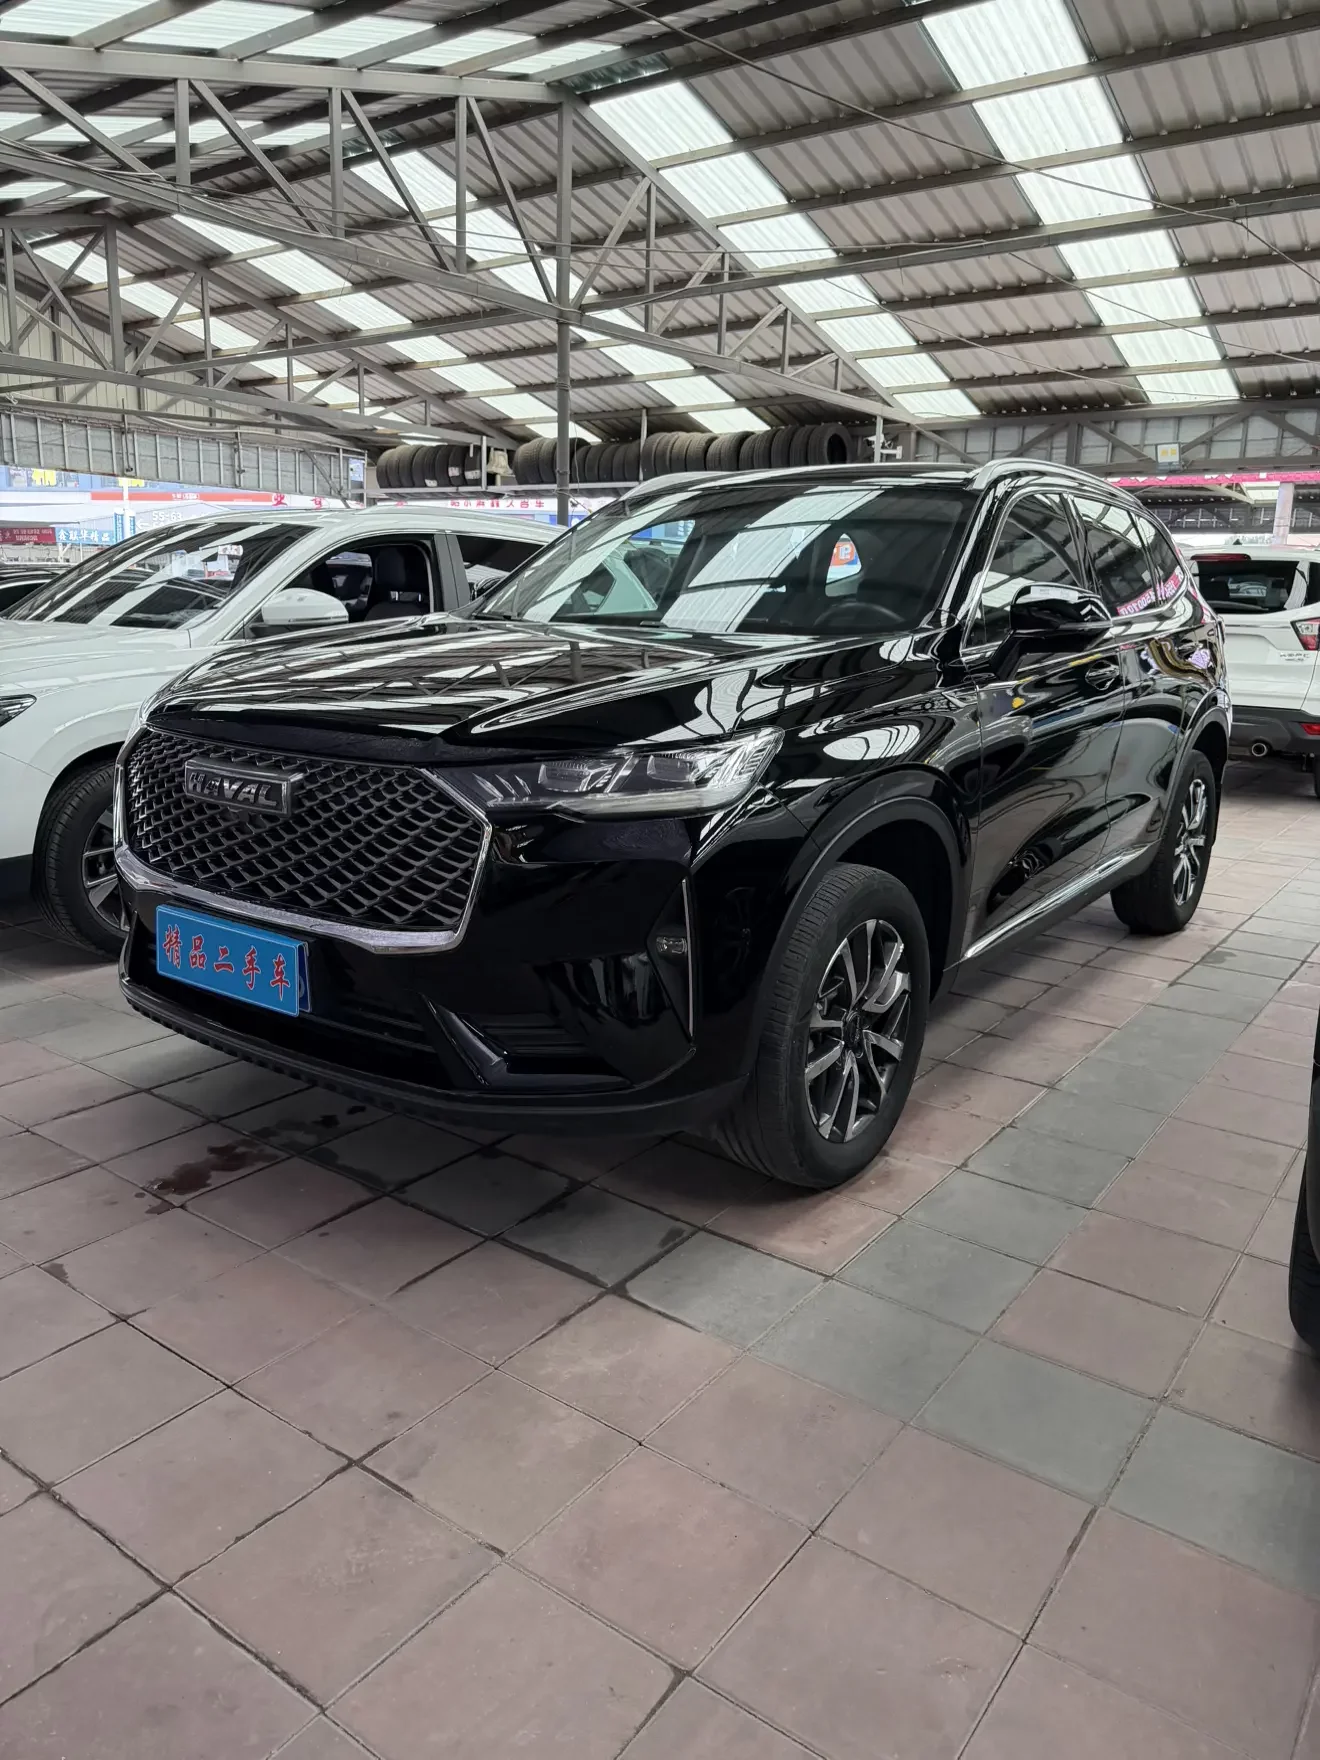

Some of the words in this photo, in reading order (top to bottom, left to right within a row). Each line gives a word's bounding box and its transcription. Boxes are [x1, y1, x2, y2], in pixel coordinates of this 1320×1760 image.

[189, 771, 277, 806] HAVAL
[162, 924, 291, 1001] 精品二手车
